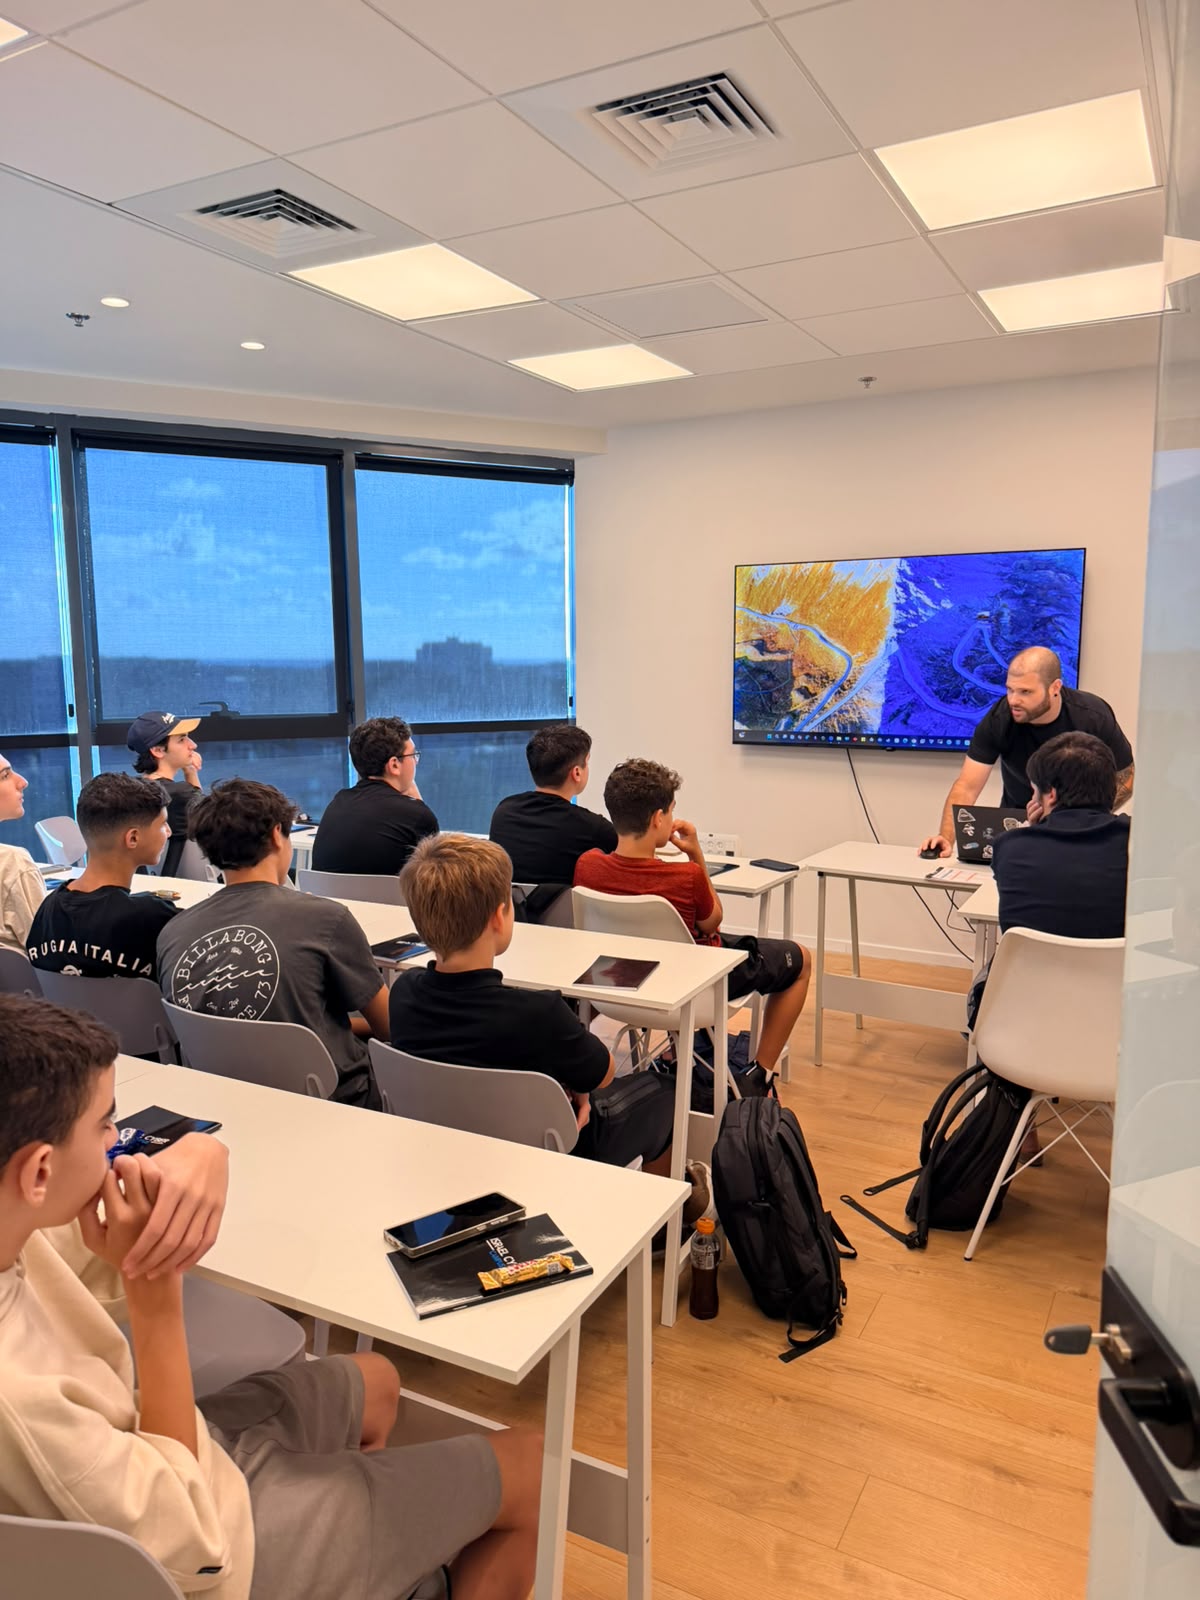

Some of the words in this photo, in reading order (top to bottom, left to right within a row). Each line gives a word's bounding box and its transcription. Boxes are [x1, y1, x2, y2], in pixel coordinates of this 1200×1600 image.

[83, 943, 153, 976] ITALIA
[176, 928, 272, 981] BILLABONG
[489, 1237, 510, 1257] ISRAEL
